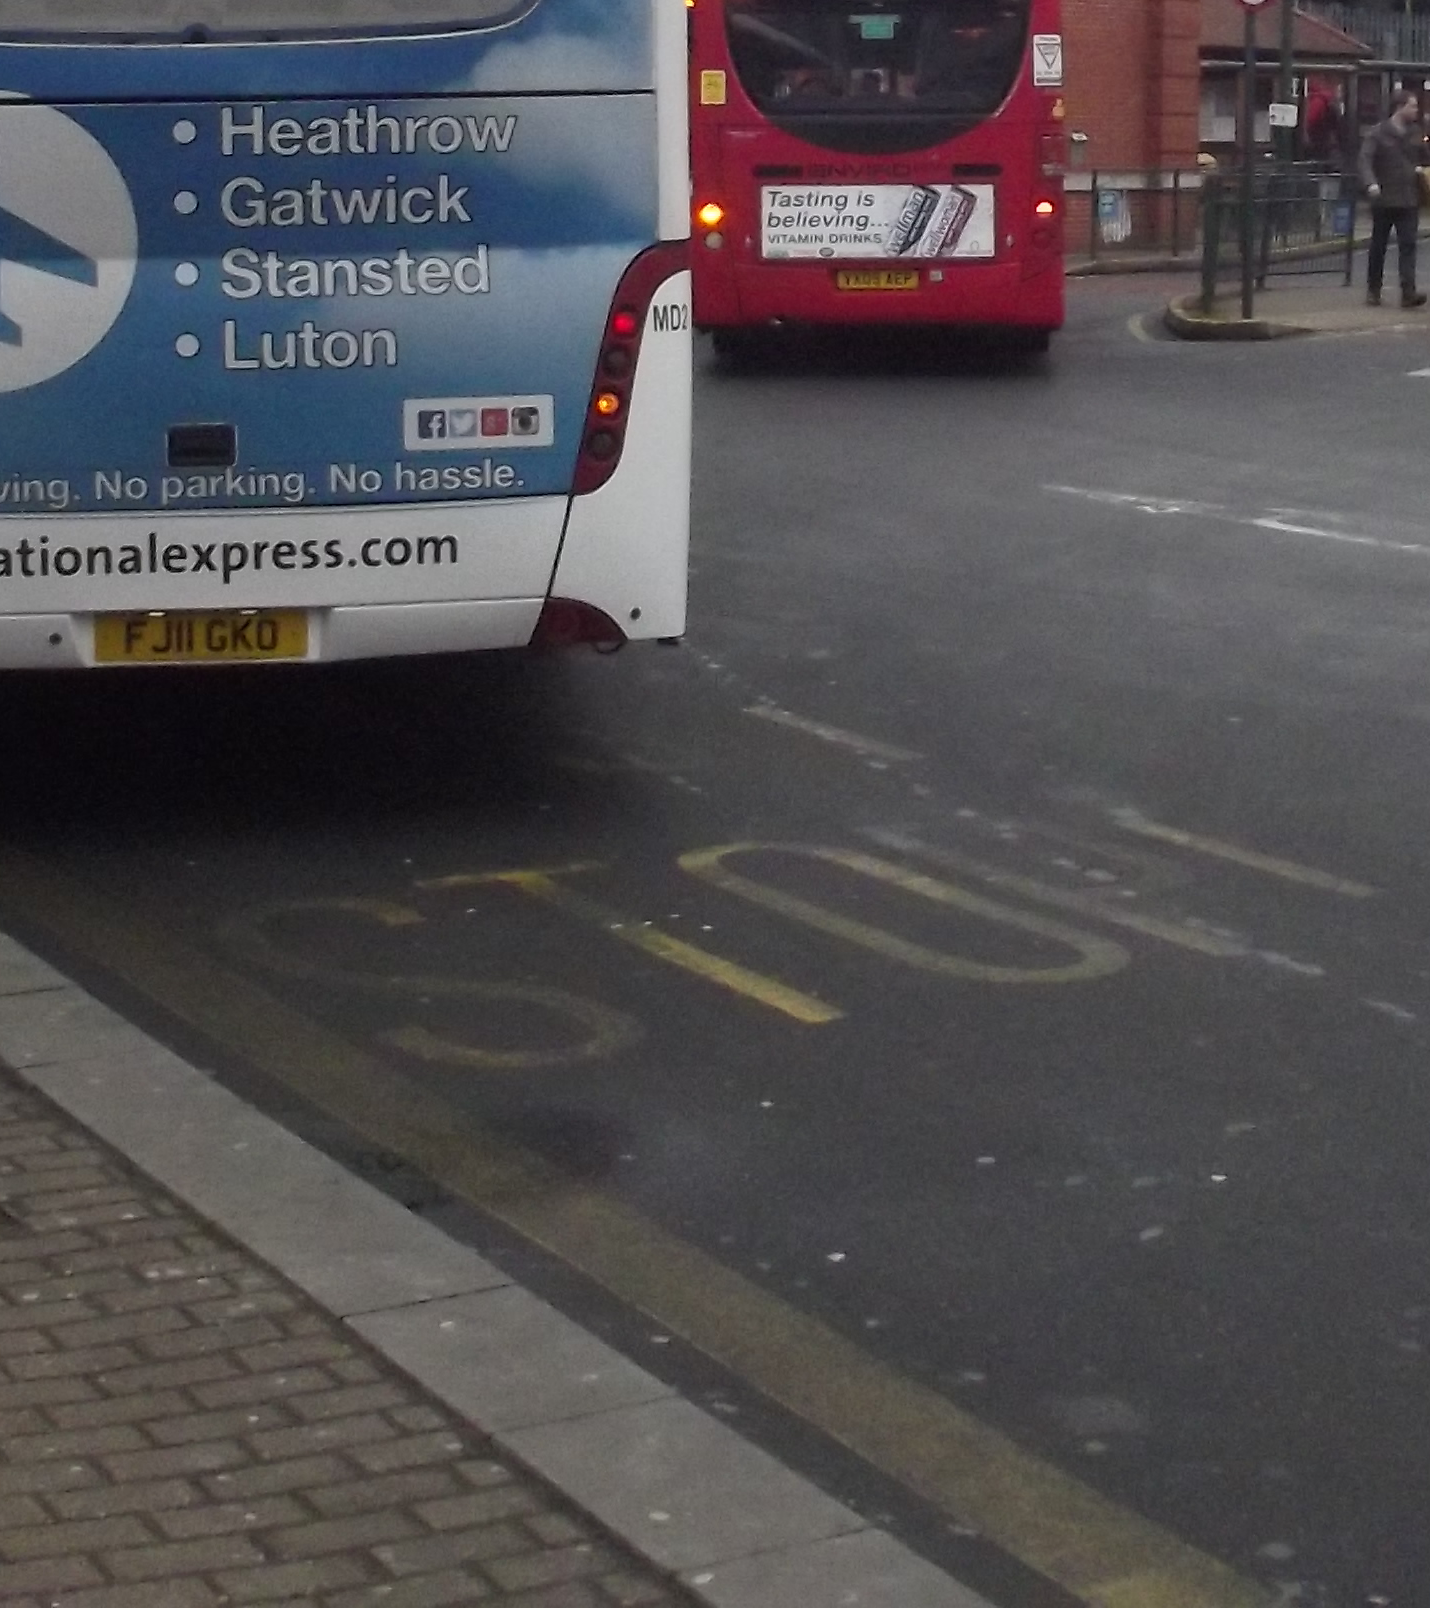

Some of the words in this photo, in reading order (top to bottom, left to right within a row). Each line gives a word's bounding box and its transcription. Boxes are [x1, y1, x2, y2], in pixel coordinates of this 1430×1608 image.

[221, 104, 518, 156] Heathrow
[221, 174, 472, 228] Gatwick
[767, 212, 890, 230] believing...
[768, 191, 849, 208] Tasting
[857, 191, 875, 207] is
[886, 191, 926, 256] wellman
[768, 234, 824, 244] VITAMIN
[829, 234, 882, 244] DRINKS
[221, 244, 491, 299] Stansted
[224, 319, 398, 371] Luton
[94, 469, 148, 501] No
[162, 466, 317, 505] parking.
[329, 463, 383, 493] No
[394, 458, 526, 491] hassle.
